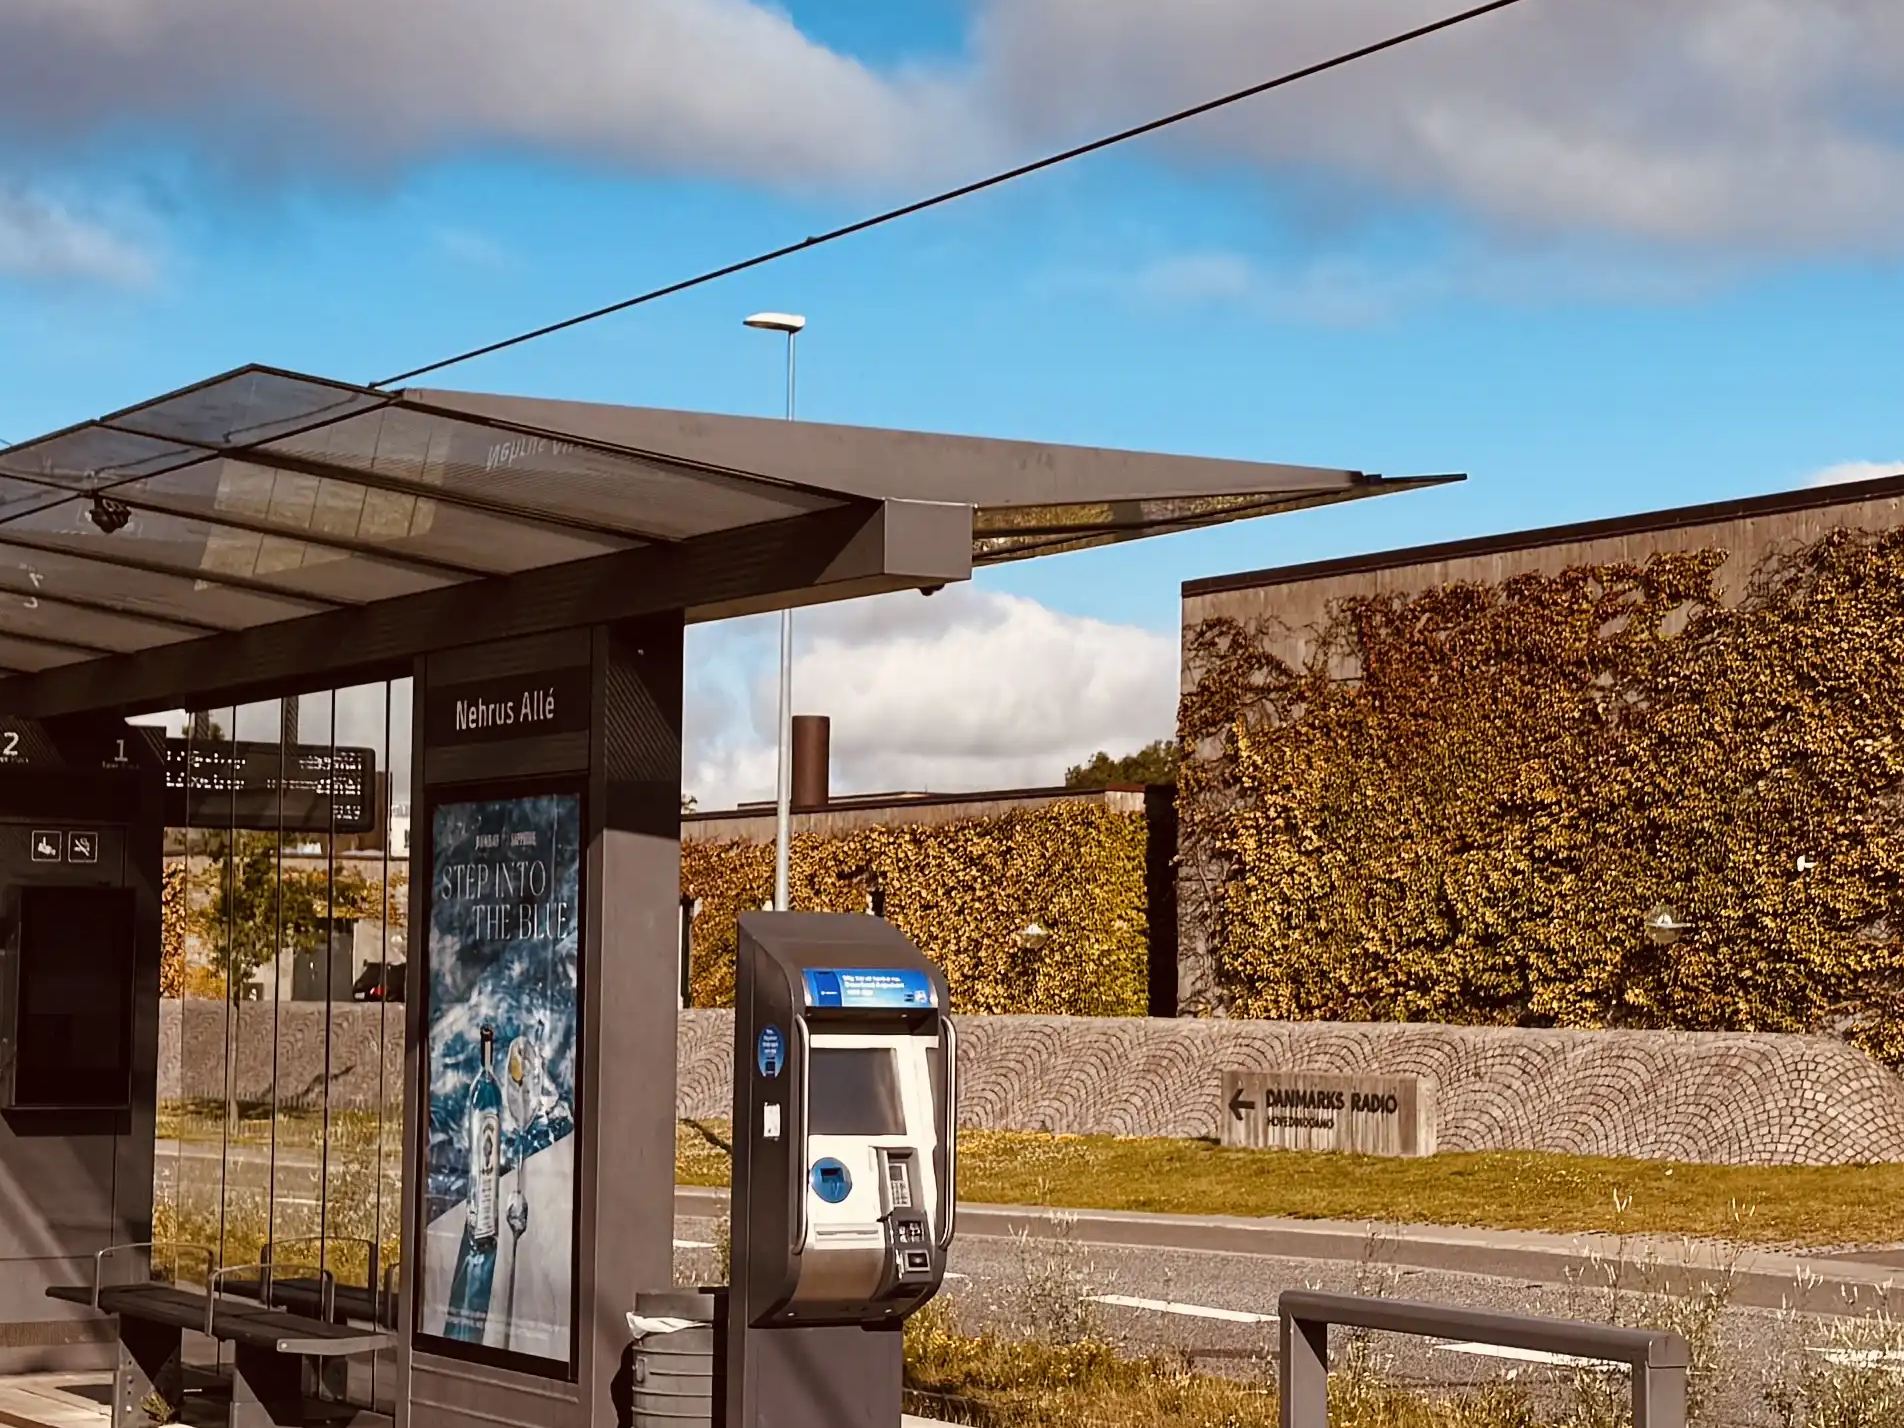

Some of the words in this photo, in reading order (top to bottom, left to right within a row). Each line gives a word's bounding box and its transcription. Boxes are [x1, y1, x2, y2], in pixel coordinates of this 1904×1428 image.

[455, 698, 514, 731] Nehrus
[520, 688, 555, 722] Allé
[2, 732, 20, 756] 2
[114, 739, 128, 762] 1
[441, 862, 489, 900] STEP
[495, 860, 546, 898] INTO
[472, 903, 511, 940] THE
[519, 902, 569, 939] BLUE
[1265, 1088, 1345, 1110] DANMARKS
[1350, 1092, 1398, 1114] RADIO
